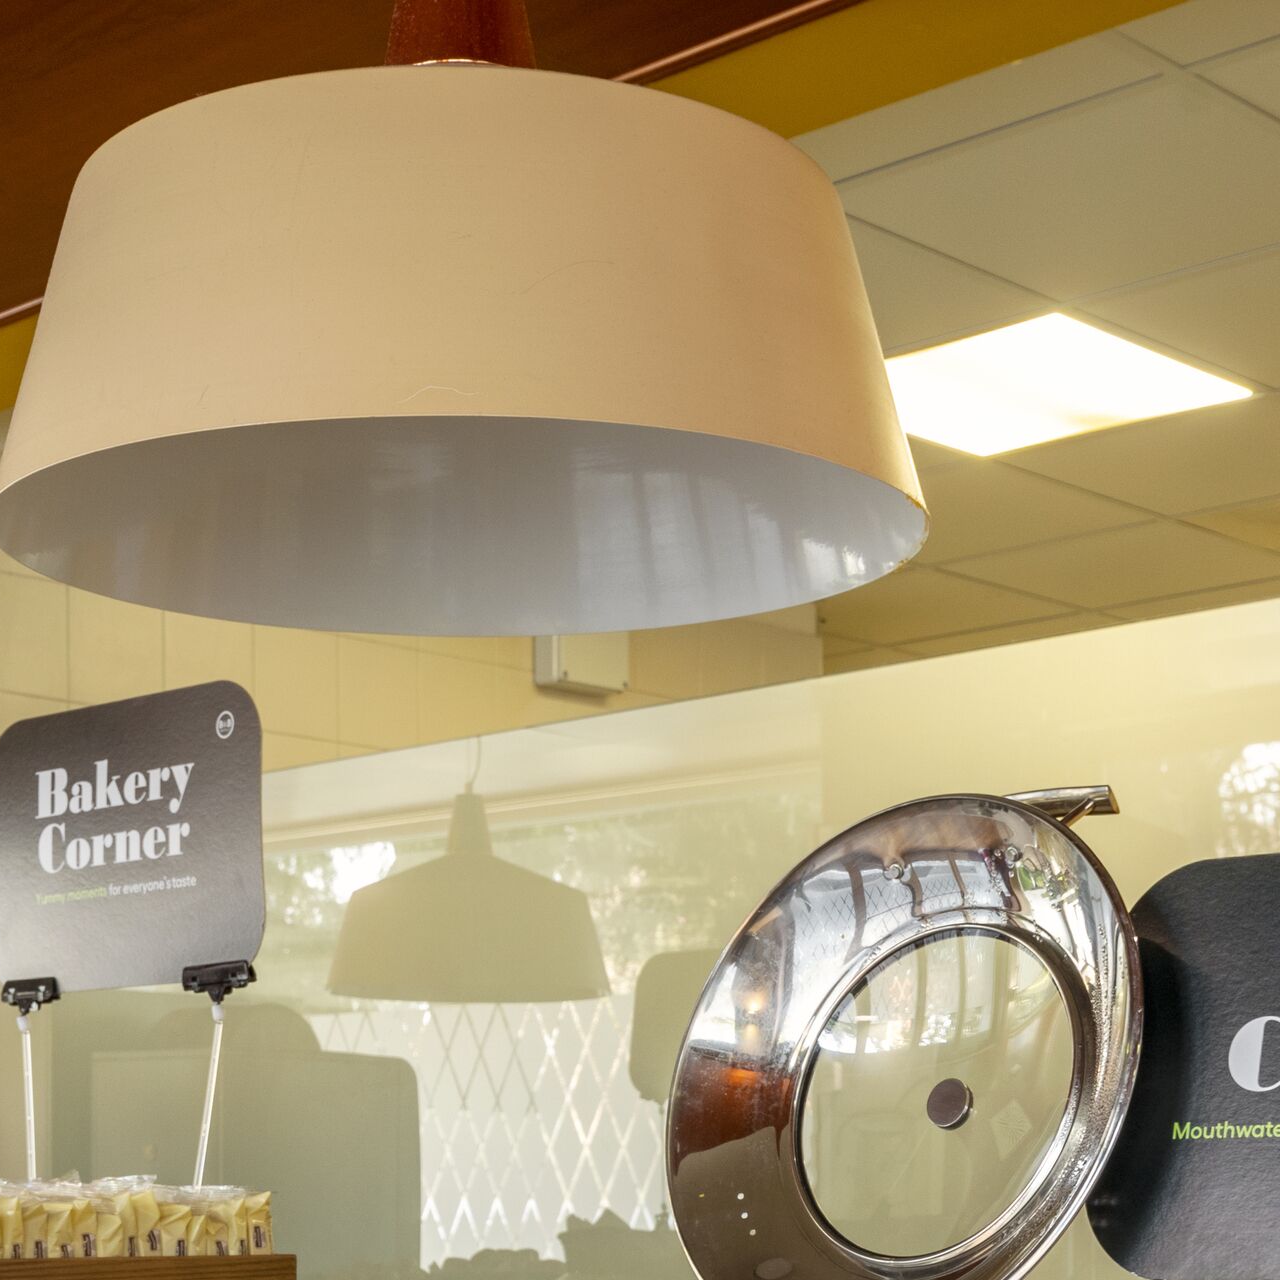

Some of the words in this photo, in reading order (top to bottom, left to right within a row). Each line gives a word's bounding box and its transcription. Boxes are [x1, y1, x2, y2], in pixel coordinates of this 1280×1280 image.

[35, 759, 195, 819] Bakery
[38, 822, 191, 874] Corner
[108, 883, 121, 896] for
[172, 876, 197, 889] taste
